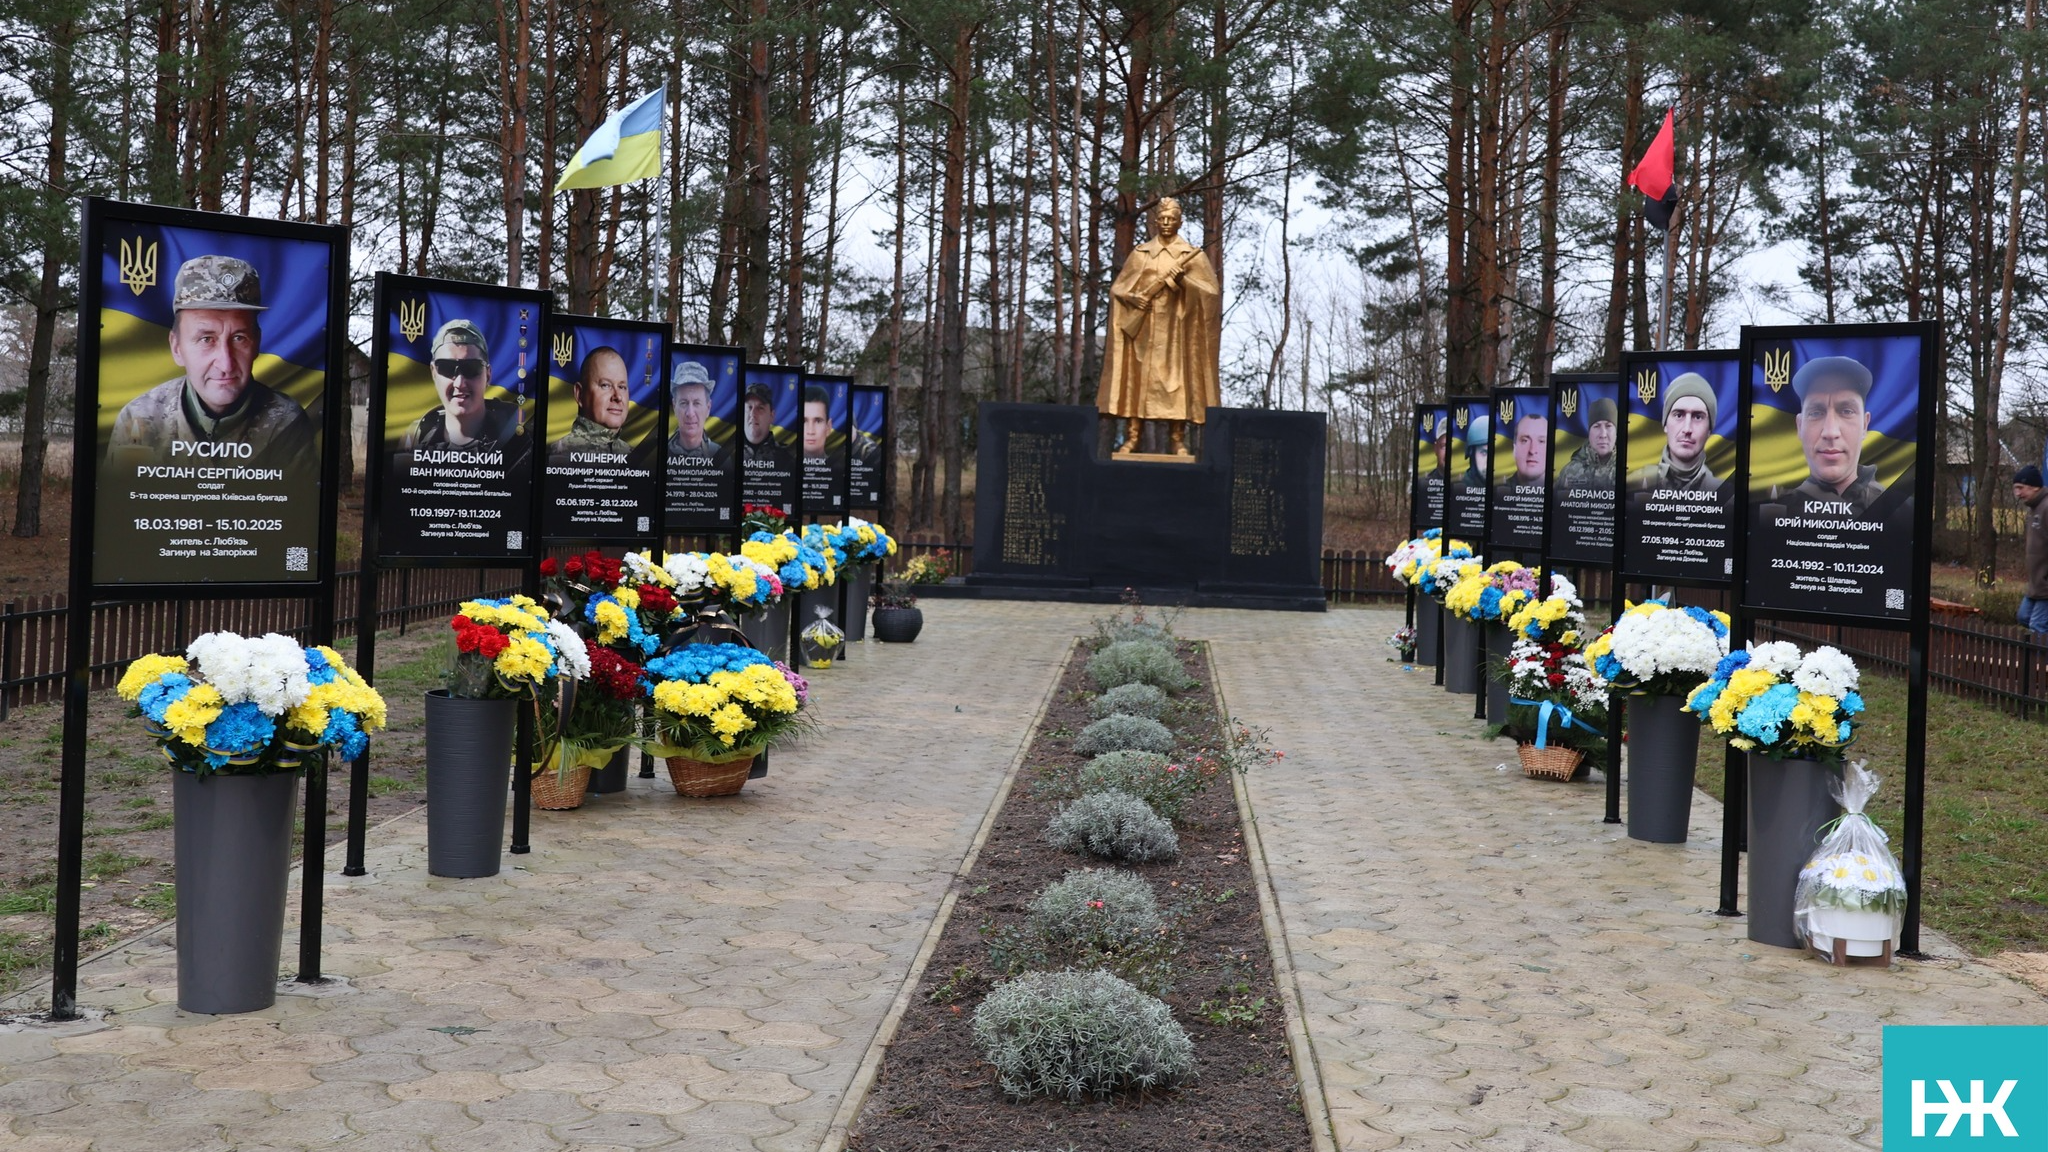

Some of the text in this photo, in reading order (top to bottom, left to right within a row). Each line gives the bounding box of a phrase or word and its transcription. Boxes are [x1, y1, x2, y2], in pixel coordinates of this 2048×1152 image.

[172, 441, 252, 458] РУСИЛО
[414, 450, 502, 465] БАДИВСЬКИЙ
[570, 452, 627, 464] КУШНЕРИК
[138, 466, 282, 480] РУСЛАН СЕРГІЙОВИЧ
[410, 468, 504, 479] ІВАН МИКОЛАЙОВИЧ
[546, 467, 649, 477] ВОЛОДИМИР МИКОЛАЙОВИЧ
[1466, 487, 1486, 495] БИШЕ
[1569, 489, 1615, 500] АБРАМОВ
[1652, 489, 1717, 501] АБРАМОВИЧ
[222, 493, 255, 501] Київська
[257, 494, 287, 502] бригада
[410, 508, 501, 518] 11.09.1997-19.11.2024
[1646, 503, 1723, 514] БОГДАН ВІКТОРОВИЧ
[1804, 501, 1852, 515] КРАТІК
[134, 519, 202, 530] 18.03.1981
[216, 519, 282, 530] 15.10.2025
[1775, 517, 1883, 531] ЮРІЙ МИКОЛАЙОВИЧ
[421, 530, 445, 538] Загинув
[1642, 536, 1679, 544] 27.05.1994
[1685, 538, 1725, 547] 20.01.2025
[159, 548, 196, 558] Загинув
[212, 548, 257, 558] Запоріжжі
[1772, 559, 1824, 570] 23.04.1992
[1833, 563, 1884, 574] 10.11.2024
[1790, 583, 1816, 591] Загинув
